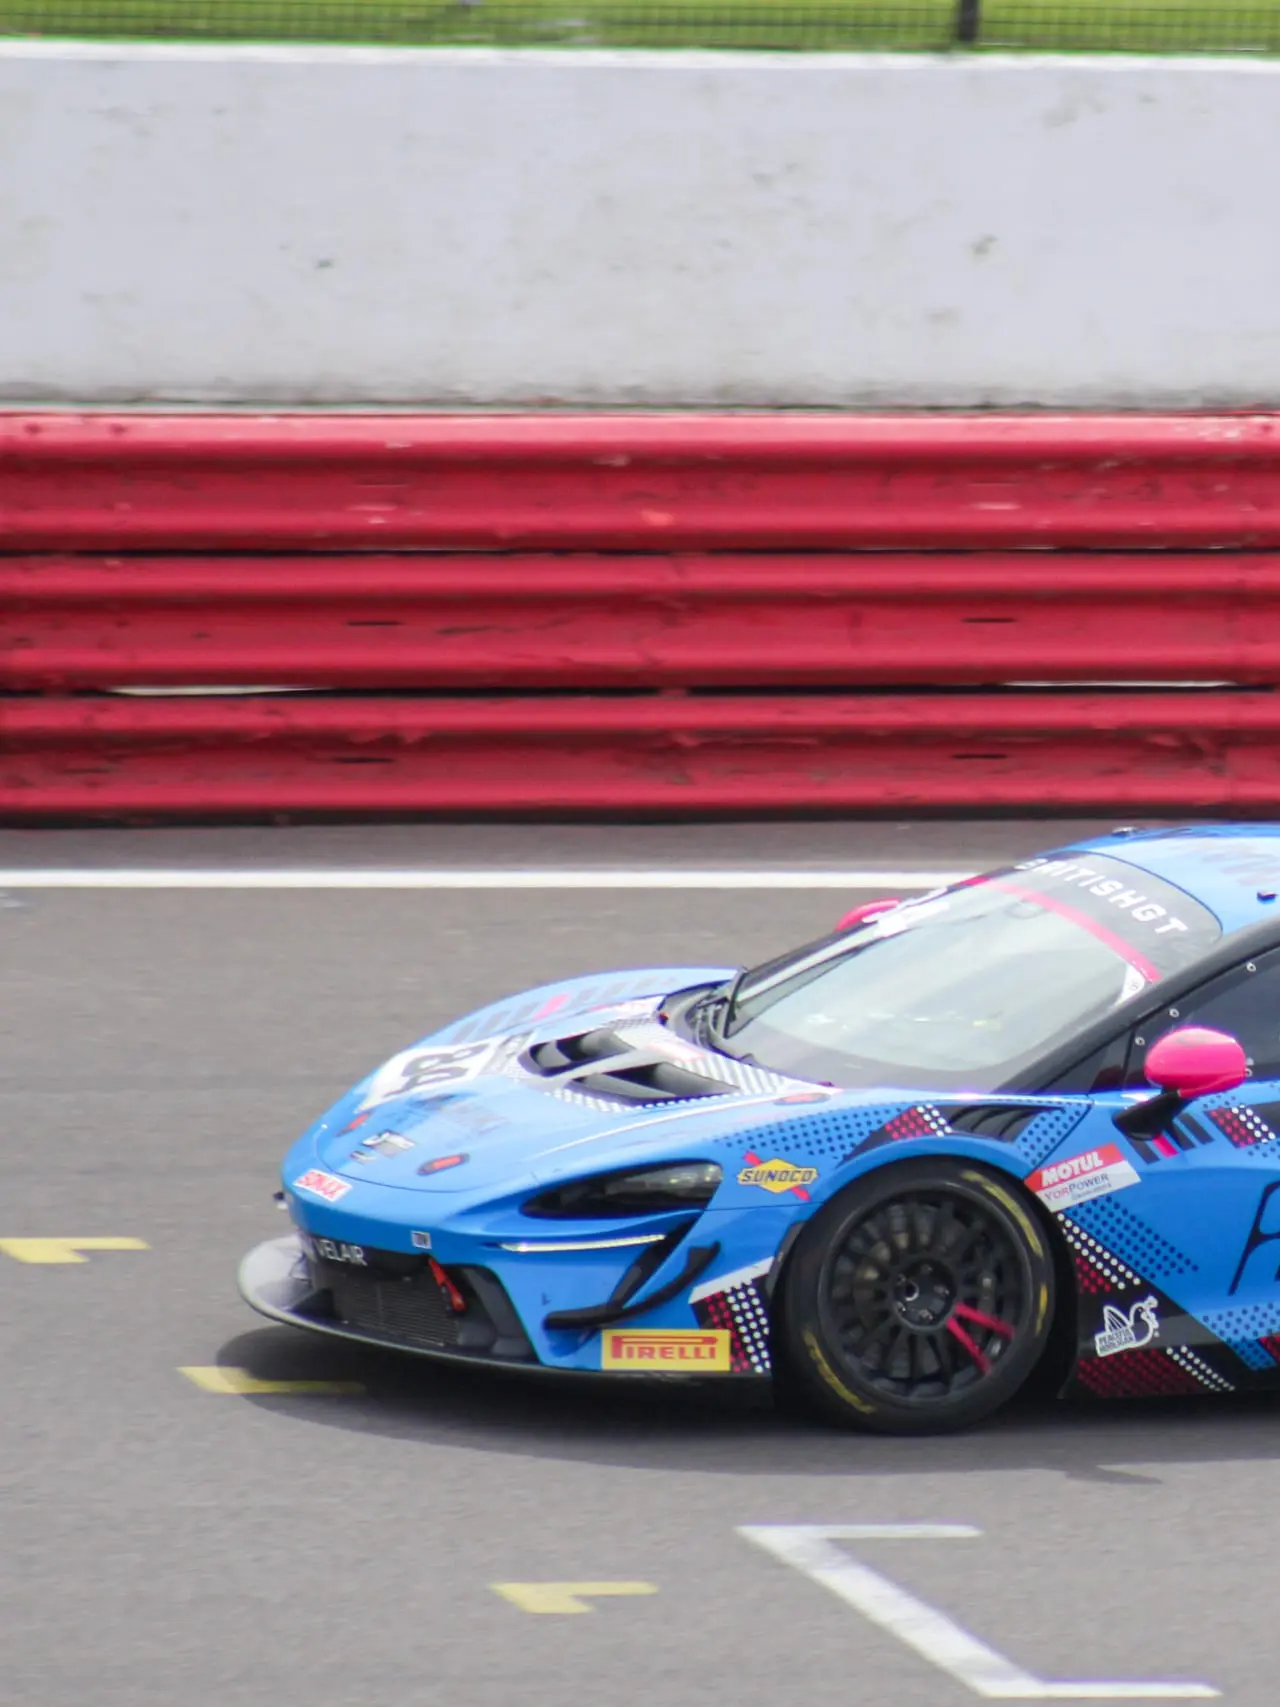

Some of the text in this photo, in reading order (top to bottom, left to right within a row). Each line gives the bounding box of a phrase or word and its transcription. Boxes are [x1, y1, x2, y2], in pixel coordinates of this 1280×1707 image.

[741, 1168, 815, 1183] SUNOCO
[1042, 1151, 1103, 1187] MOTUL
[611, 1335, 719, 1360] PIRELLI
